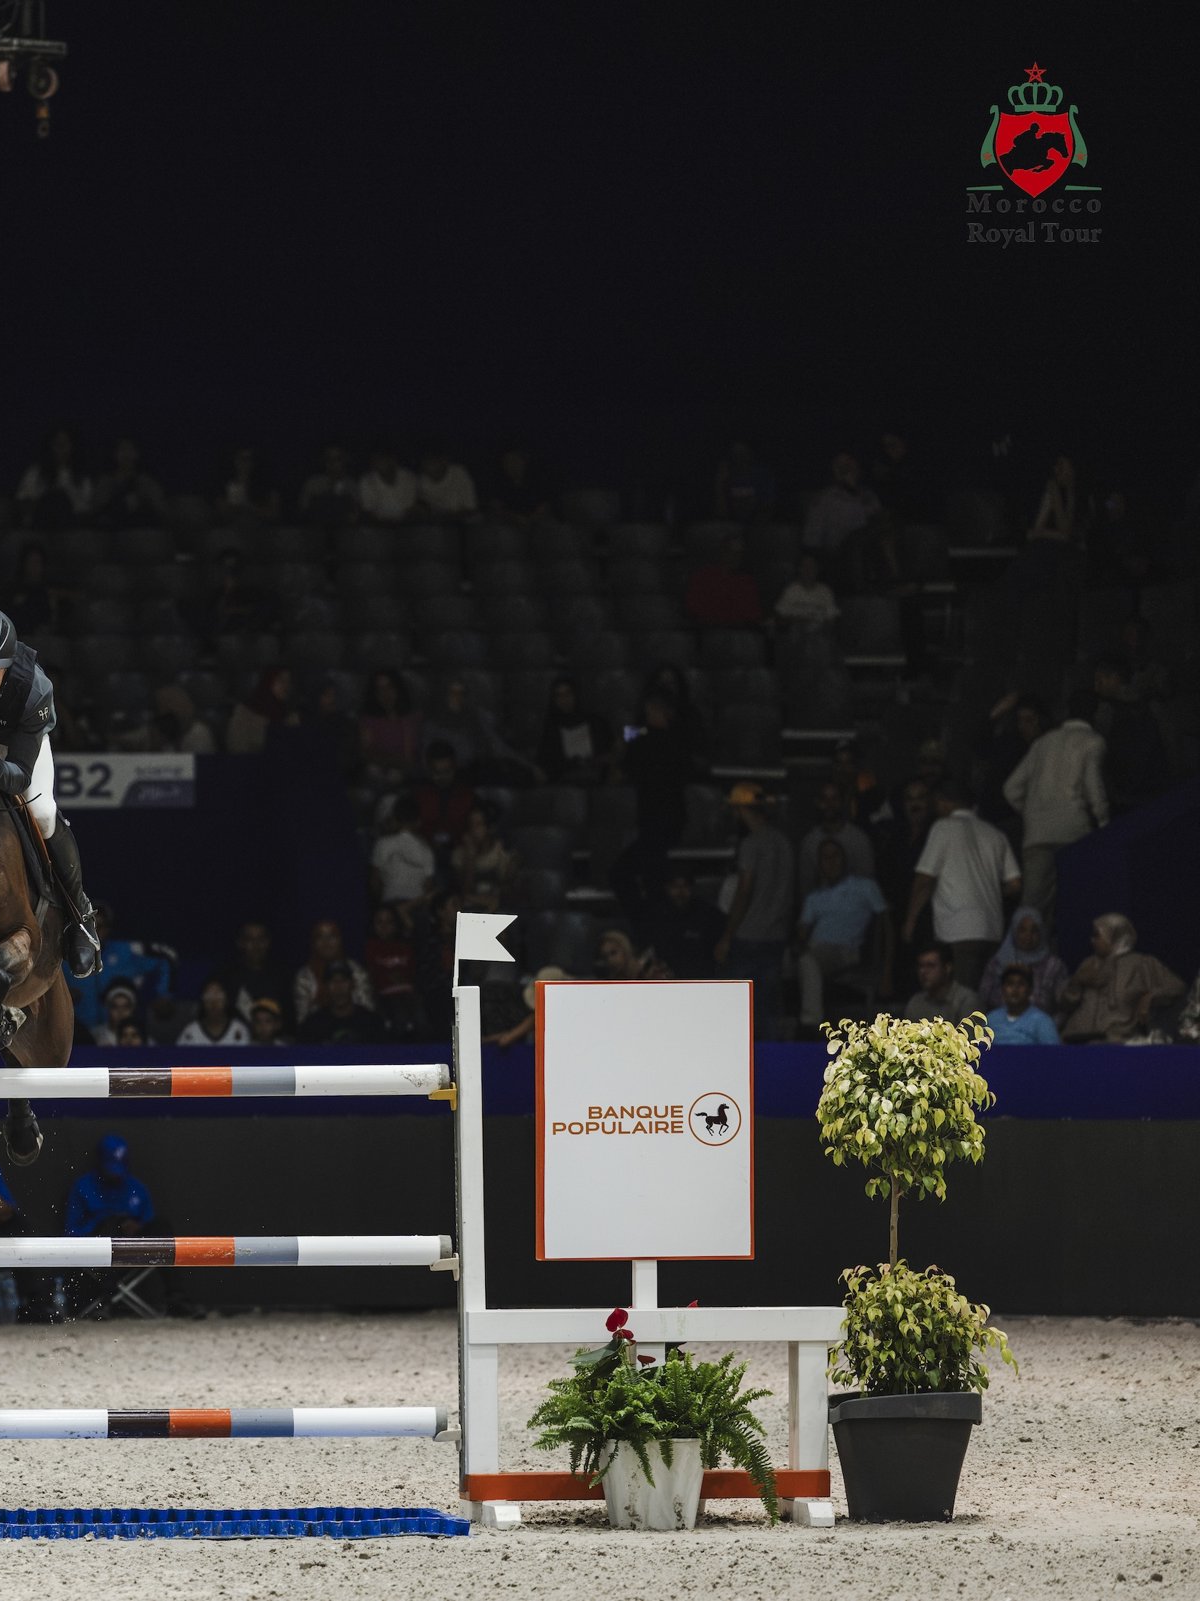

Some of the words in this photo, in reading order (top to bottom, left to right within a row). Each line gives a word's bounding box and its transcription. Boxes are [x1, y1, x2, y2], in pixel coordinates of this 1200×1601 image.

[55, 762, 114, 799] B2
[588, 1105, 684, 1120] BANQUE
[552, 1120, 684, 1135] POPULAIRE
